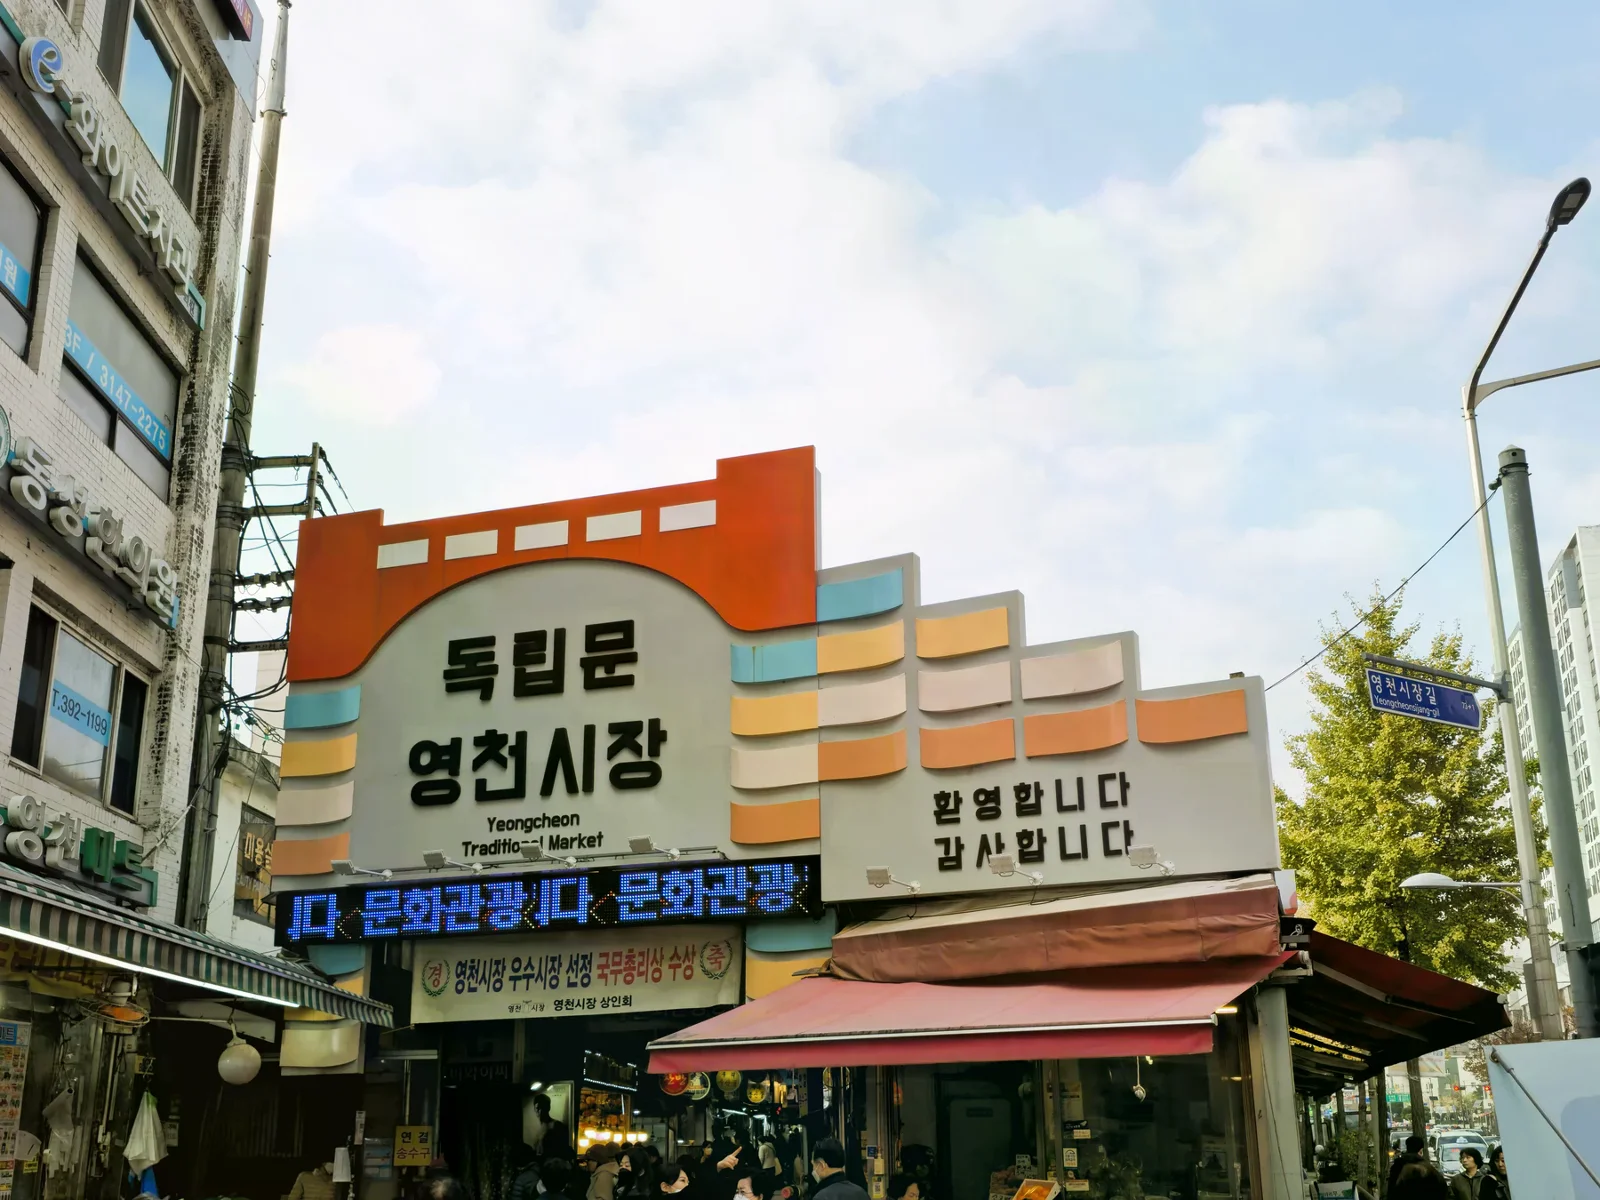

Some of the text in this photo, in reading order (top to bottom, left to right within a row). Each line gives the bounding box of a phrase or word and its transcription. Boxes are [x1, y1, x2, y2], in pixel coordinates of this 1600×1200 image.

[100, 366, 167, 450] 3147-2275
[443, 619, 638, 701] 독립문
[1371, 674, 1437, 706] 영천시장길
[1374, 694, 1440, 717] Yeongcheonsijang-gil
[53, 688, 108, 736] T.392-1199
[409, 717, 668, 807] 영천시장
[933, 771, 1131, 825] 환영합니다
[487, 812, 580, 833] Yeongcheon
[461, 831, 604, 857] Traditiol Market
[428, 943, 726, 995] 경 영천시장 우수시장 선정 국무총리상 수상 축
[553, 994, 633, 1012] 영천시장 상인회
[396, 1147, 431, 1160] 송수구
